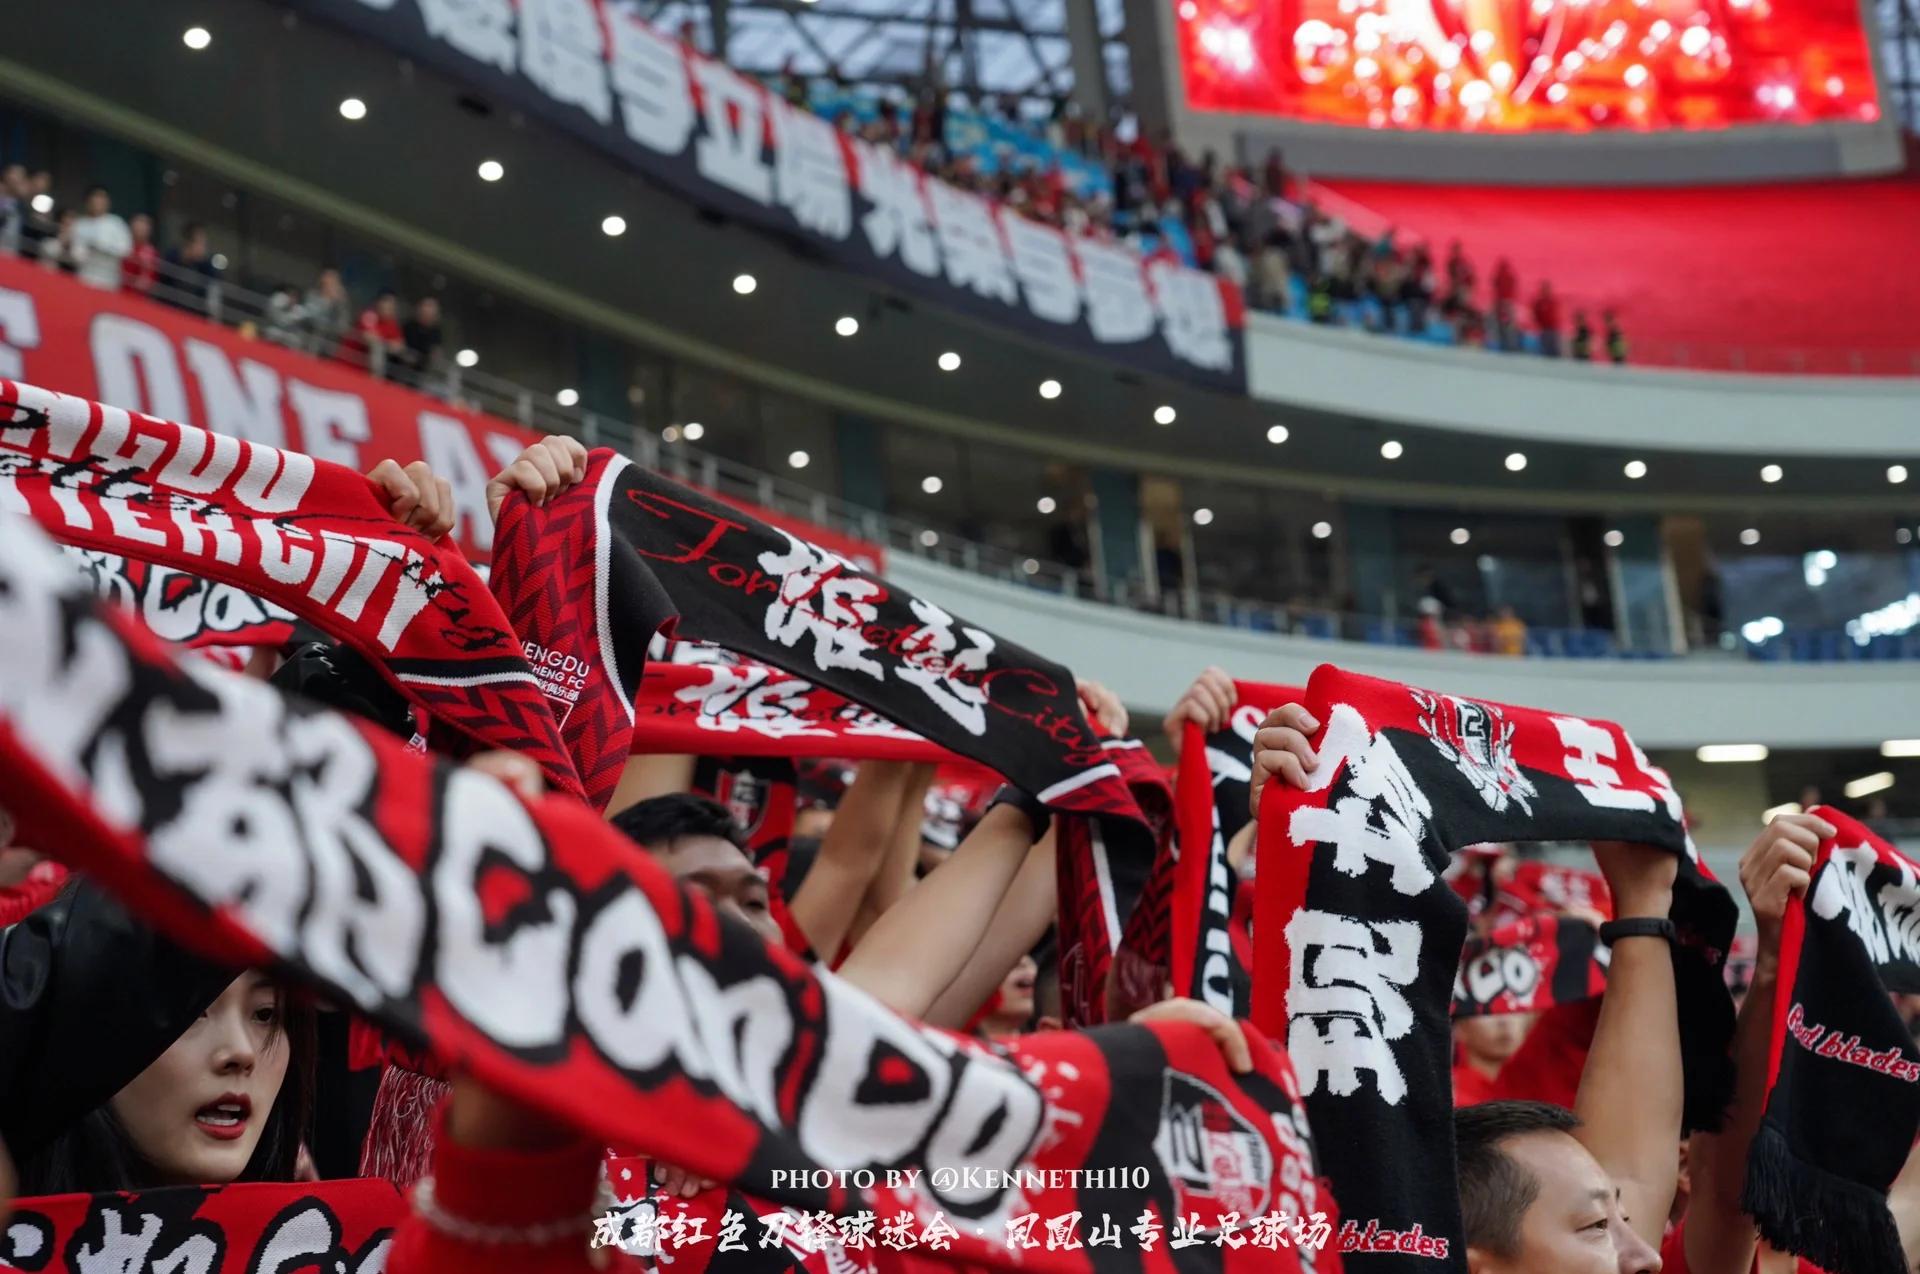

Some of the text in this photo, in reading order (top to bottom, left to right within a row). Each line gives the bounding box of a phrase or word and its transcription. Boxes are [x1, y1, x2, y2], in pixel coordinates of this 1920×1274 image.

[0, 378, 315, 514] NGDU
[254, 518, 443, 652] CITY
[521, 640, 590, 678] ENGDU
[528, 661, 586, 690] HENG FC
[1815, 1030, 1920, 1082] blades
[1339, 1219, 1450, 1259] blades
